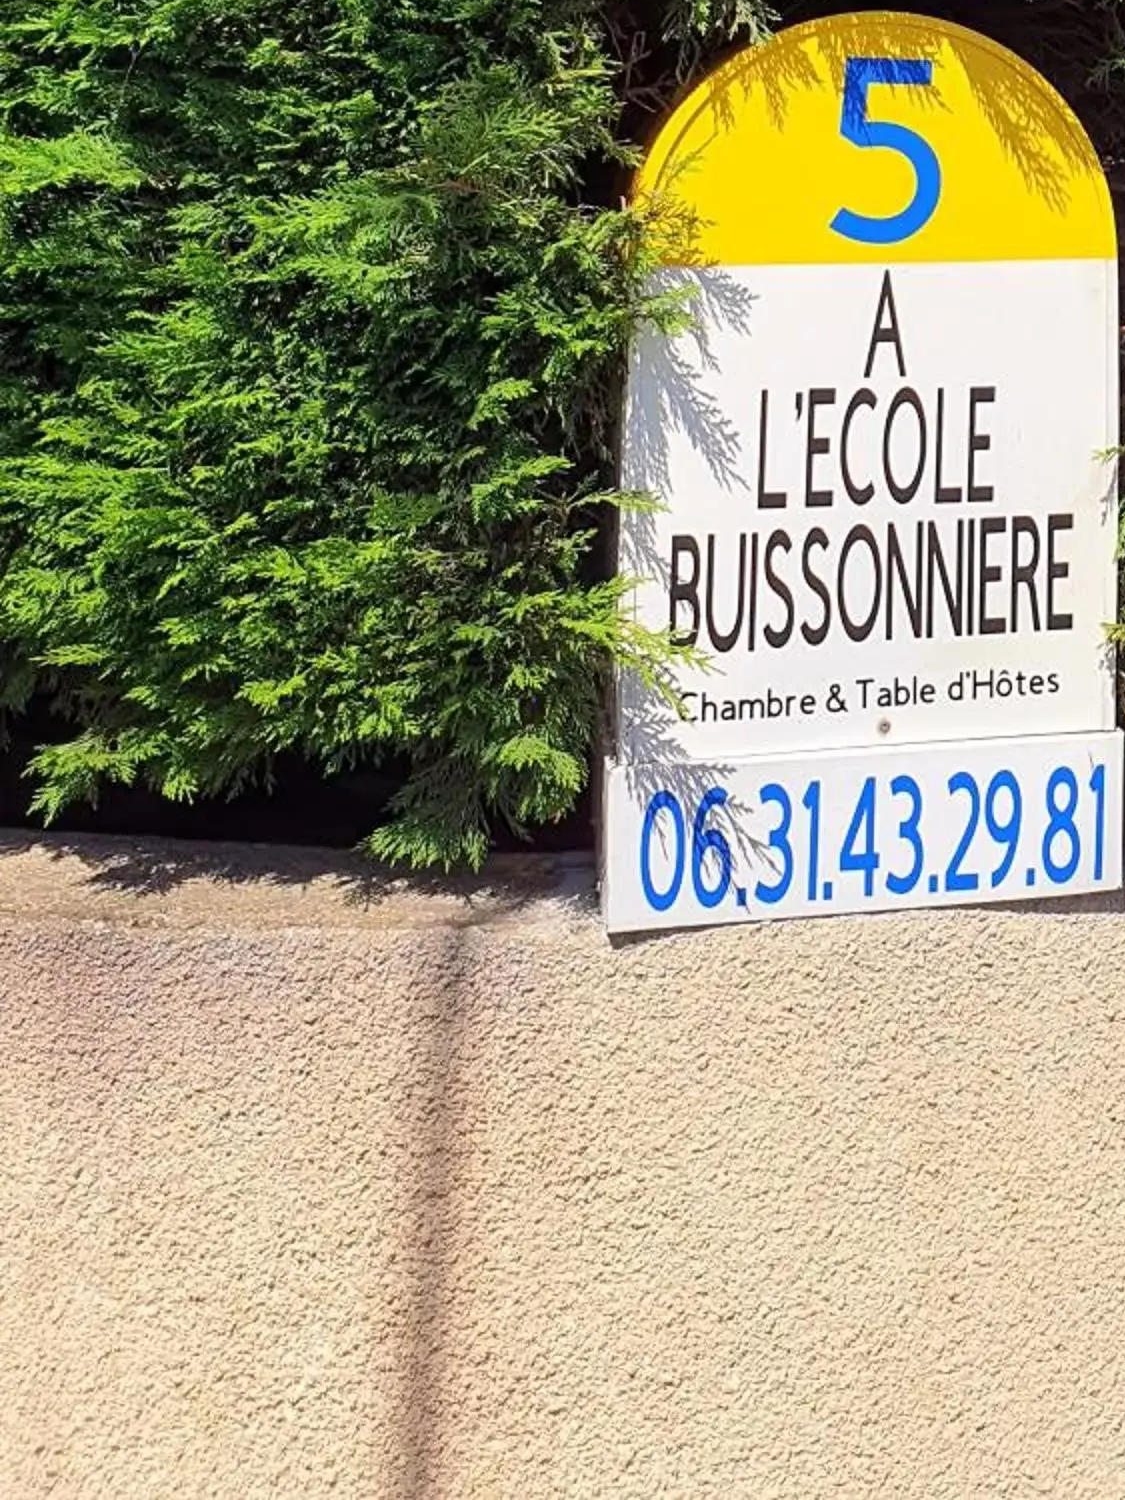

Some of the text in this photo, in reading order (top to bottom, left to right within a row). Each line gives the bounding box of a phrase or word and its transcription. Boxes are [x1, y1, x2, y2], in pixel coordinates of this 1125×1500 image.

[829, 56, 942, 244] 5
[863, 269, 906, 378] A
[757, 386, 996, 509] L'ECOLE
[669, 513, 1074, 653] BUISSONNIERE
[680, 668, 1060, 723] Chambre & Table d'Hôtes
[640, 764, 1106, 912] 06.31.43.29.81
